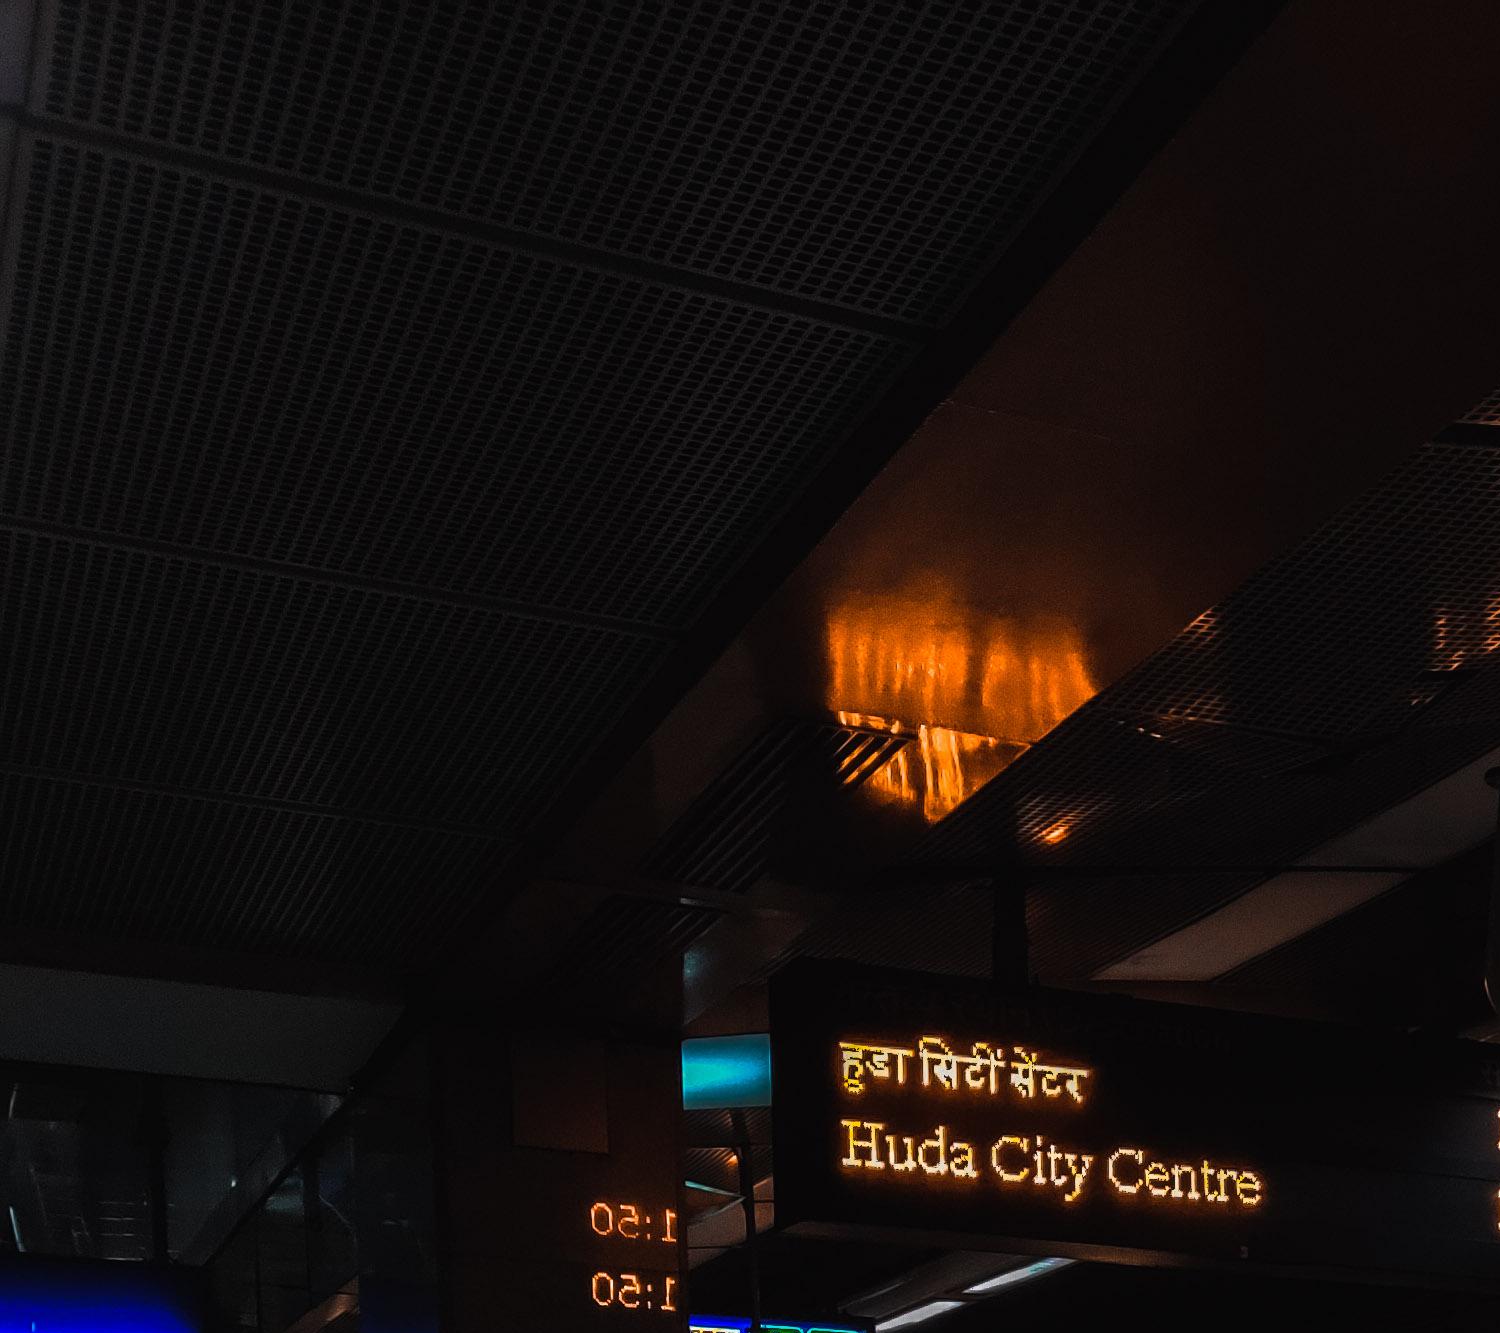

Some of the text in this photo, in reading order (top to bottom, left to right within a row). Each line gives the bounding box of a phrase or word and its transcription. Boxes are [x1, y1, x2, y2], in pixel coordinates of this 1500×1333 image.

[918, 1036, 1006, 1096] सिटी
[1010, 1046, 1090, 1104] सेंटर
[840, 1118, 1264, 1206] Huda City Centre
